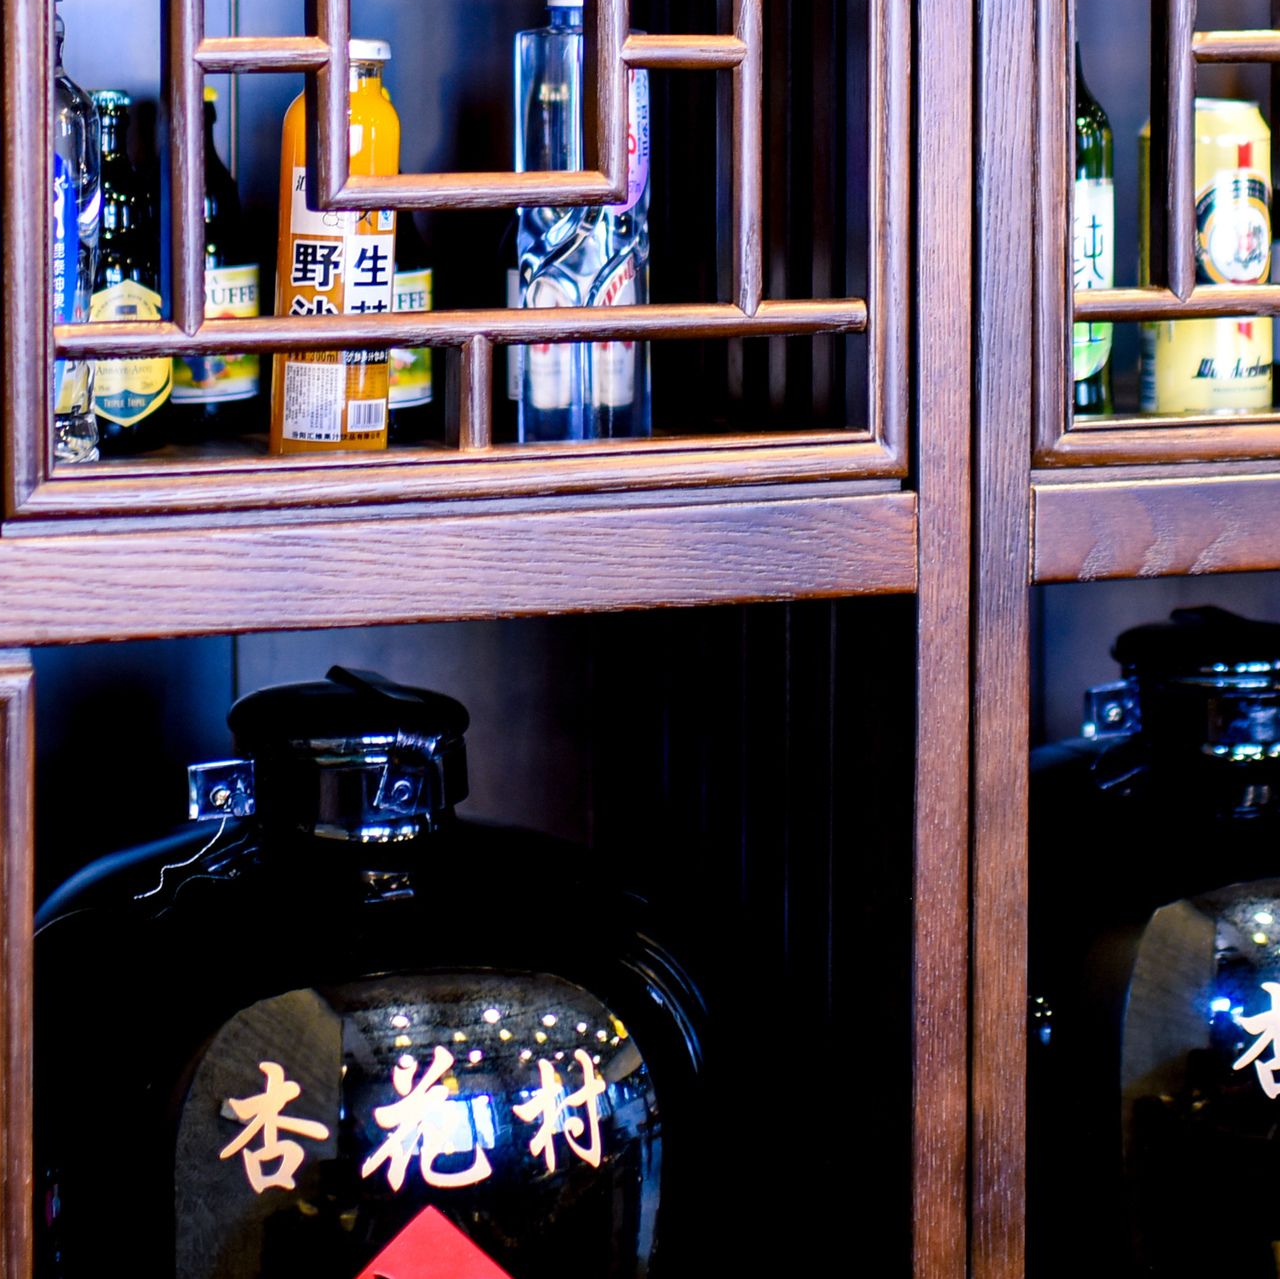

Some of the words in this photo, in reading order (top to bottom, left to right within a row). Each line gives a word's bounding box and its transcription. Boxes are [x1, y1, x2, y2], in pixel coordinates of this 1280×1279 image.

[292, 243, 388, 288] 野生
[219, 1044, 608, 1195] 杏花村
